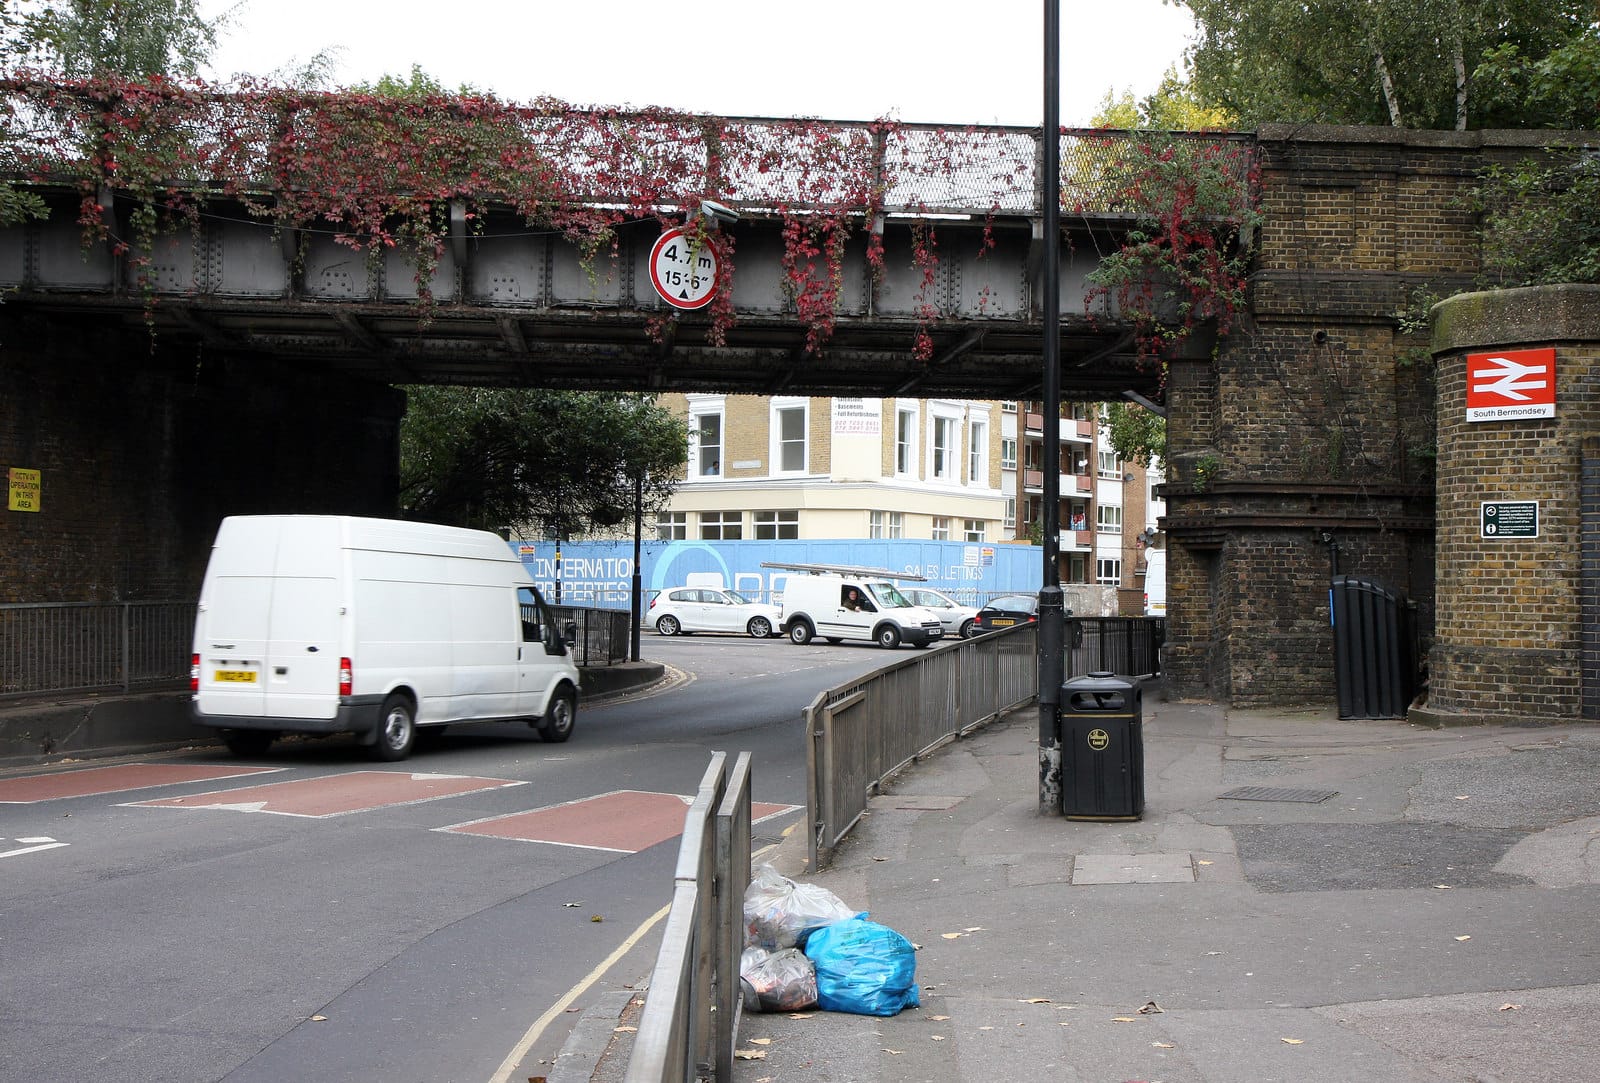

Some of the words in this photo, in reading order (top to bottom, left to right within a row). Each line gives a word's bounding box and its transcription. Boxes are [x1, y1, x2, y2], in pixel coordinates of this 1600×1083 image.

[1473, 410, 1495, 418] South
[1497, 407, 1547, 416] Bermondsey
[11, 481, 39, 490] OPERATION
[17, 500, 32, 508] AREA
